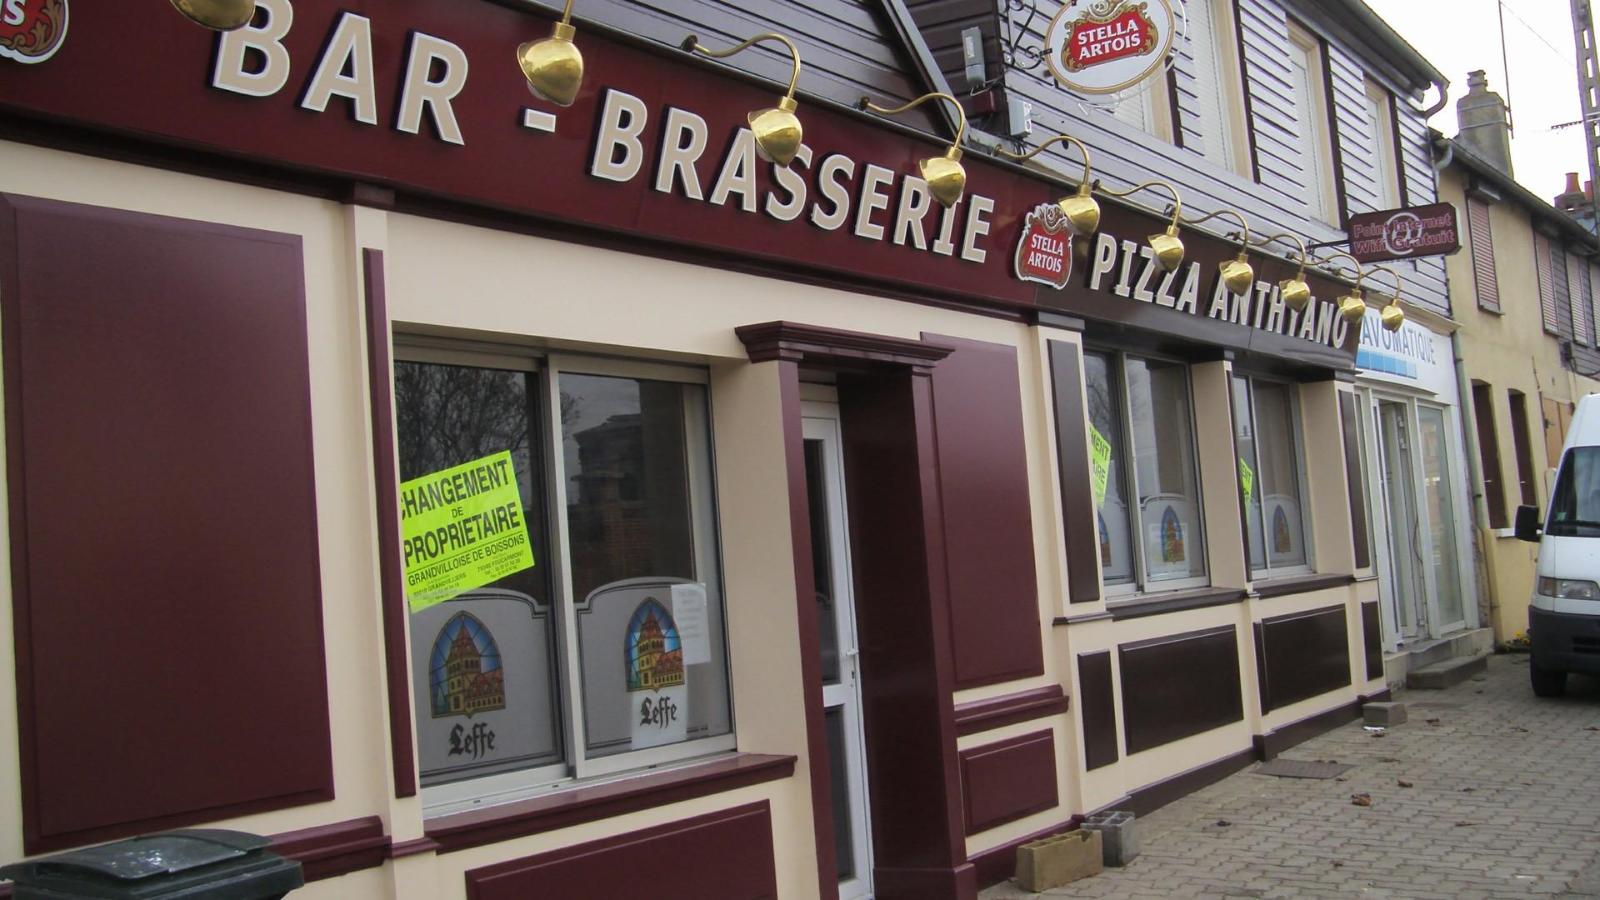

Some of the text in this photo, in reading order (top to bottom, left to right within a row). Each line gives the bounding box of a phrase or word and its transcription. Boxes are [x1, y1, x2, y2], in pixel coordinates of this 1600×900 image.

[1077, 19, 1139, 45] STELLA
[1079, 33, 1141, 60] ARTOIS
[213, 0, 465, 146] BAR
[591, 89, 995, 263] BRASSERIE
[1031, 234, 1064, 256] STELLA
[1353, 222, 1391, 239] Point
[1028, 251, 1062, 273] ARTOIS
[1090, 233, 1200, 315] PIZZA
[451, 506, 464, 519] DE
[404, 502, 521, 568] PROPRIETAIRE
[408, 555, 470, 586] GRANDVILLOISE
[472, 549, 485, 562] DE
[485, 534, 526, 557] BOISSONS
[640, 696, 678, 730] Leffe
[448, 722, 497, 761] Leffe
